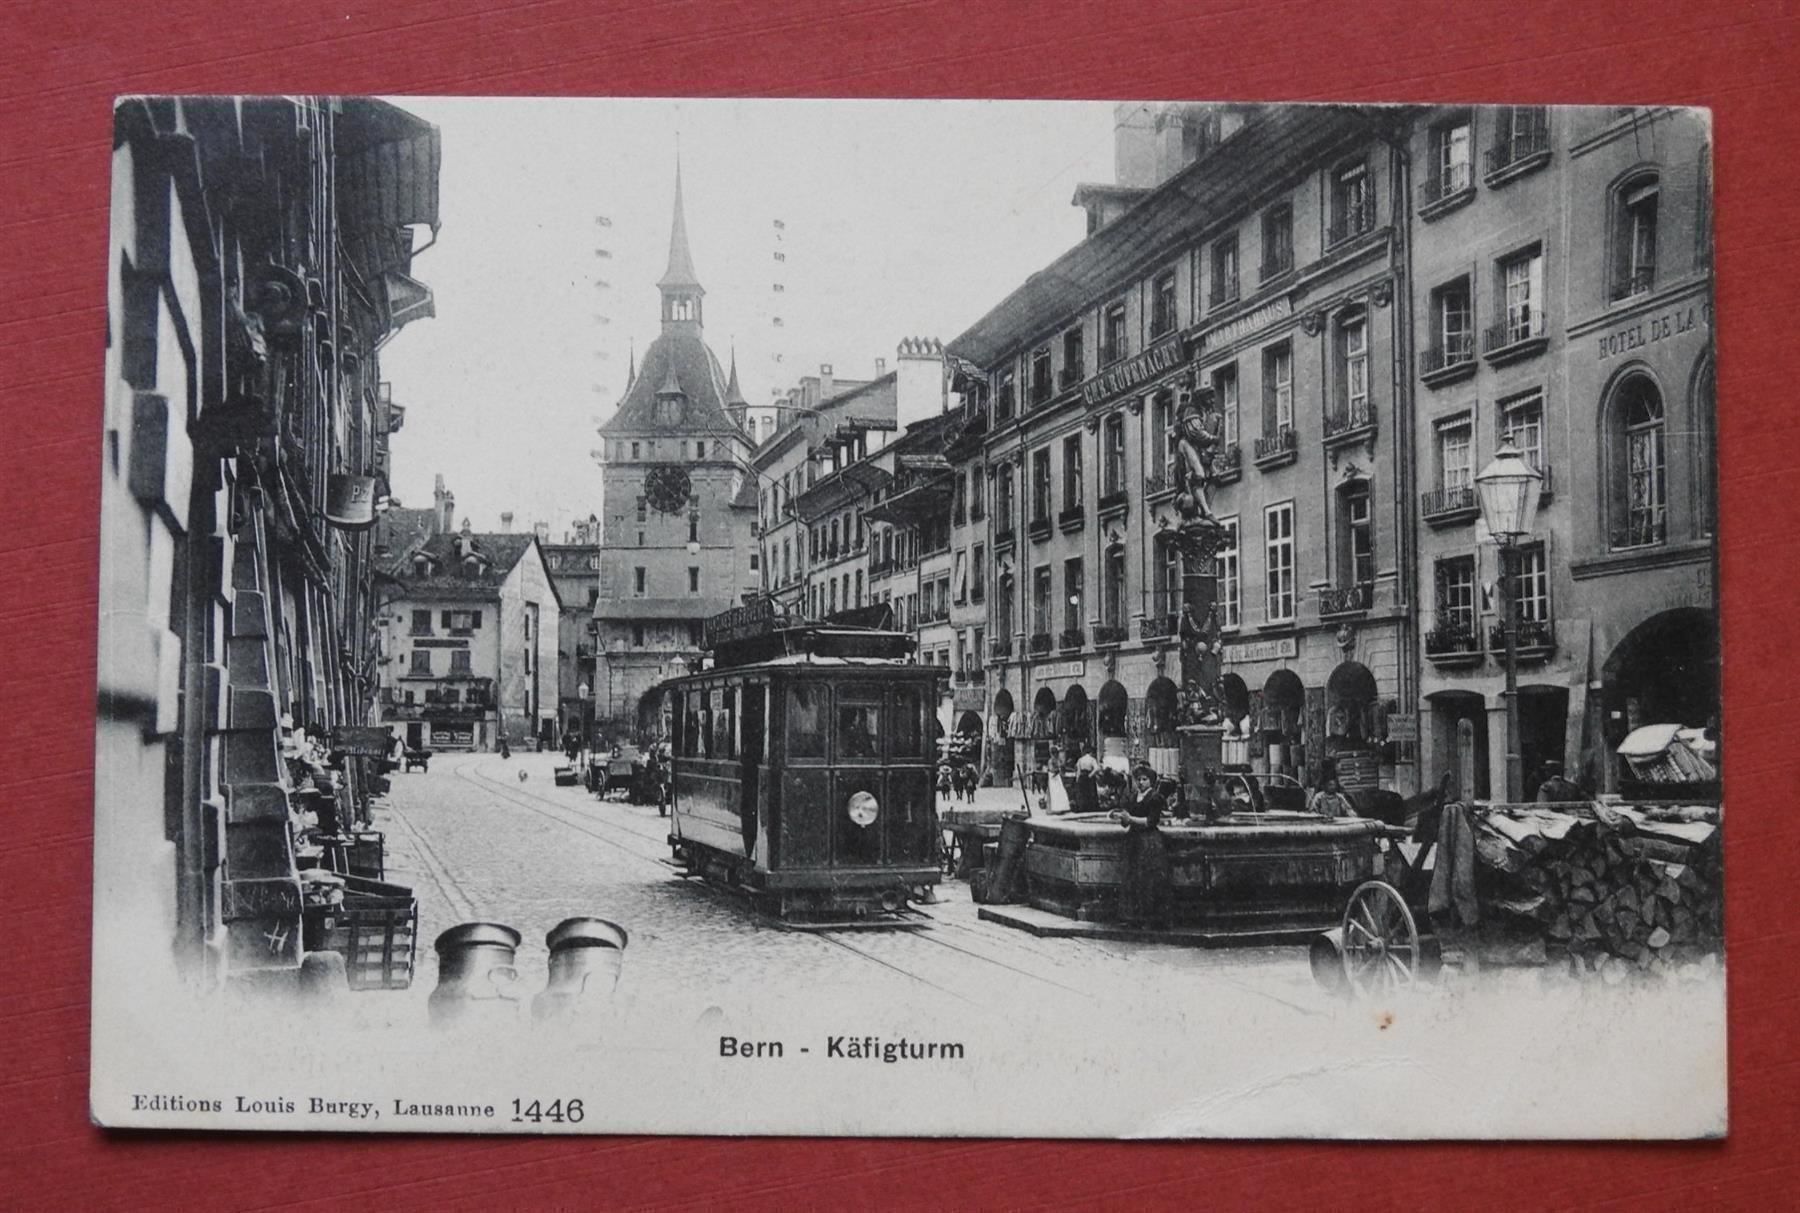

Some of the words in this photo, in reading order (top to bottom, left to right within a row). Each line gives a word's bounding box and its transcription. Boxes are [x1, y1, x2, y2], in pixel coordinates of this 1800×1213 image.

[1598, 326, 1647, 360] HOTEL
[1651, 315, 1672, 343] DE
[1676, 307, 1696, 334] LA
[719, 1036, 784, 1058] Bern
[827, 1036, 965, 1063] Käfigturm
[131, 1094, 222, 1112] Editions
[235, 1096, 295, 1114] Louis
[308, 1097, 380, 1120] Burgy,
[392, 1099, 495, 1118] Lausanne
[511, 1098, 585, 1124] 1446
